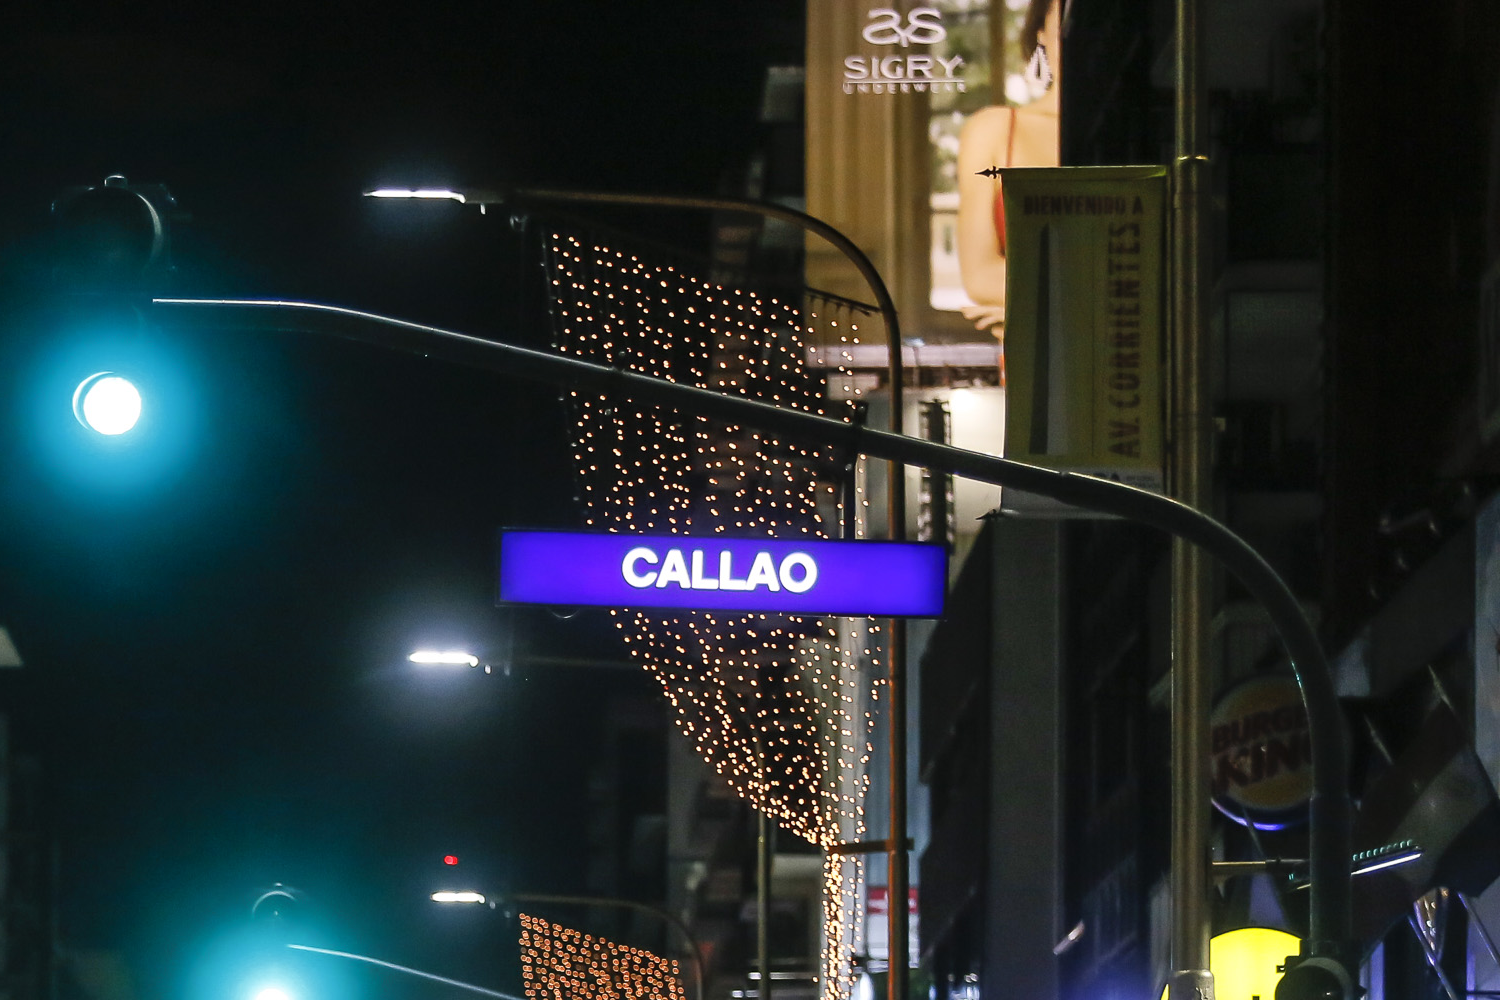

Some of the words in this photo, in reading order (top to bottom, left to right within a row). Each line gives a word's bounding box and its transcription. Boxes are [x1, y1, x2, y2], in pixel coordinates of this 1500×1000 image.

[843, 55, 963, 79] SIGRY
[1108, 221, 1141, 408] CORRIENTES
[621, 546, 818, 593] CALLAO
